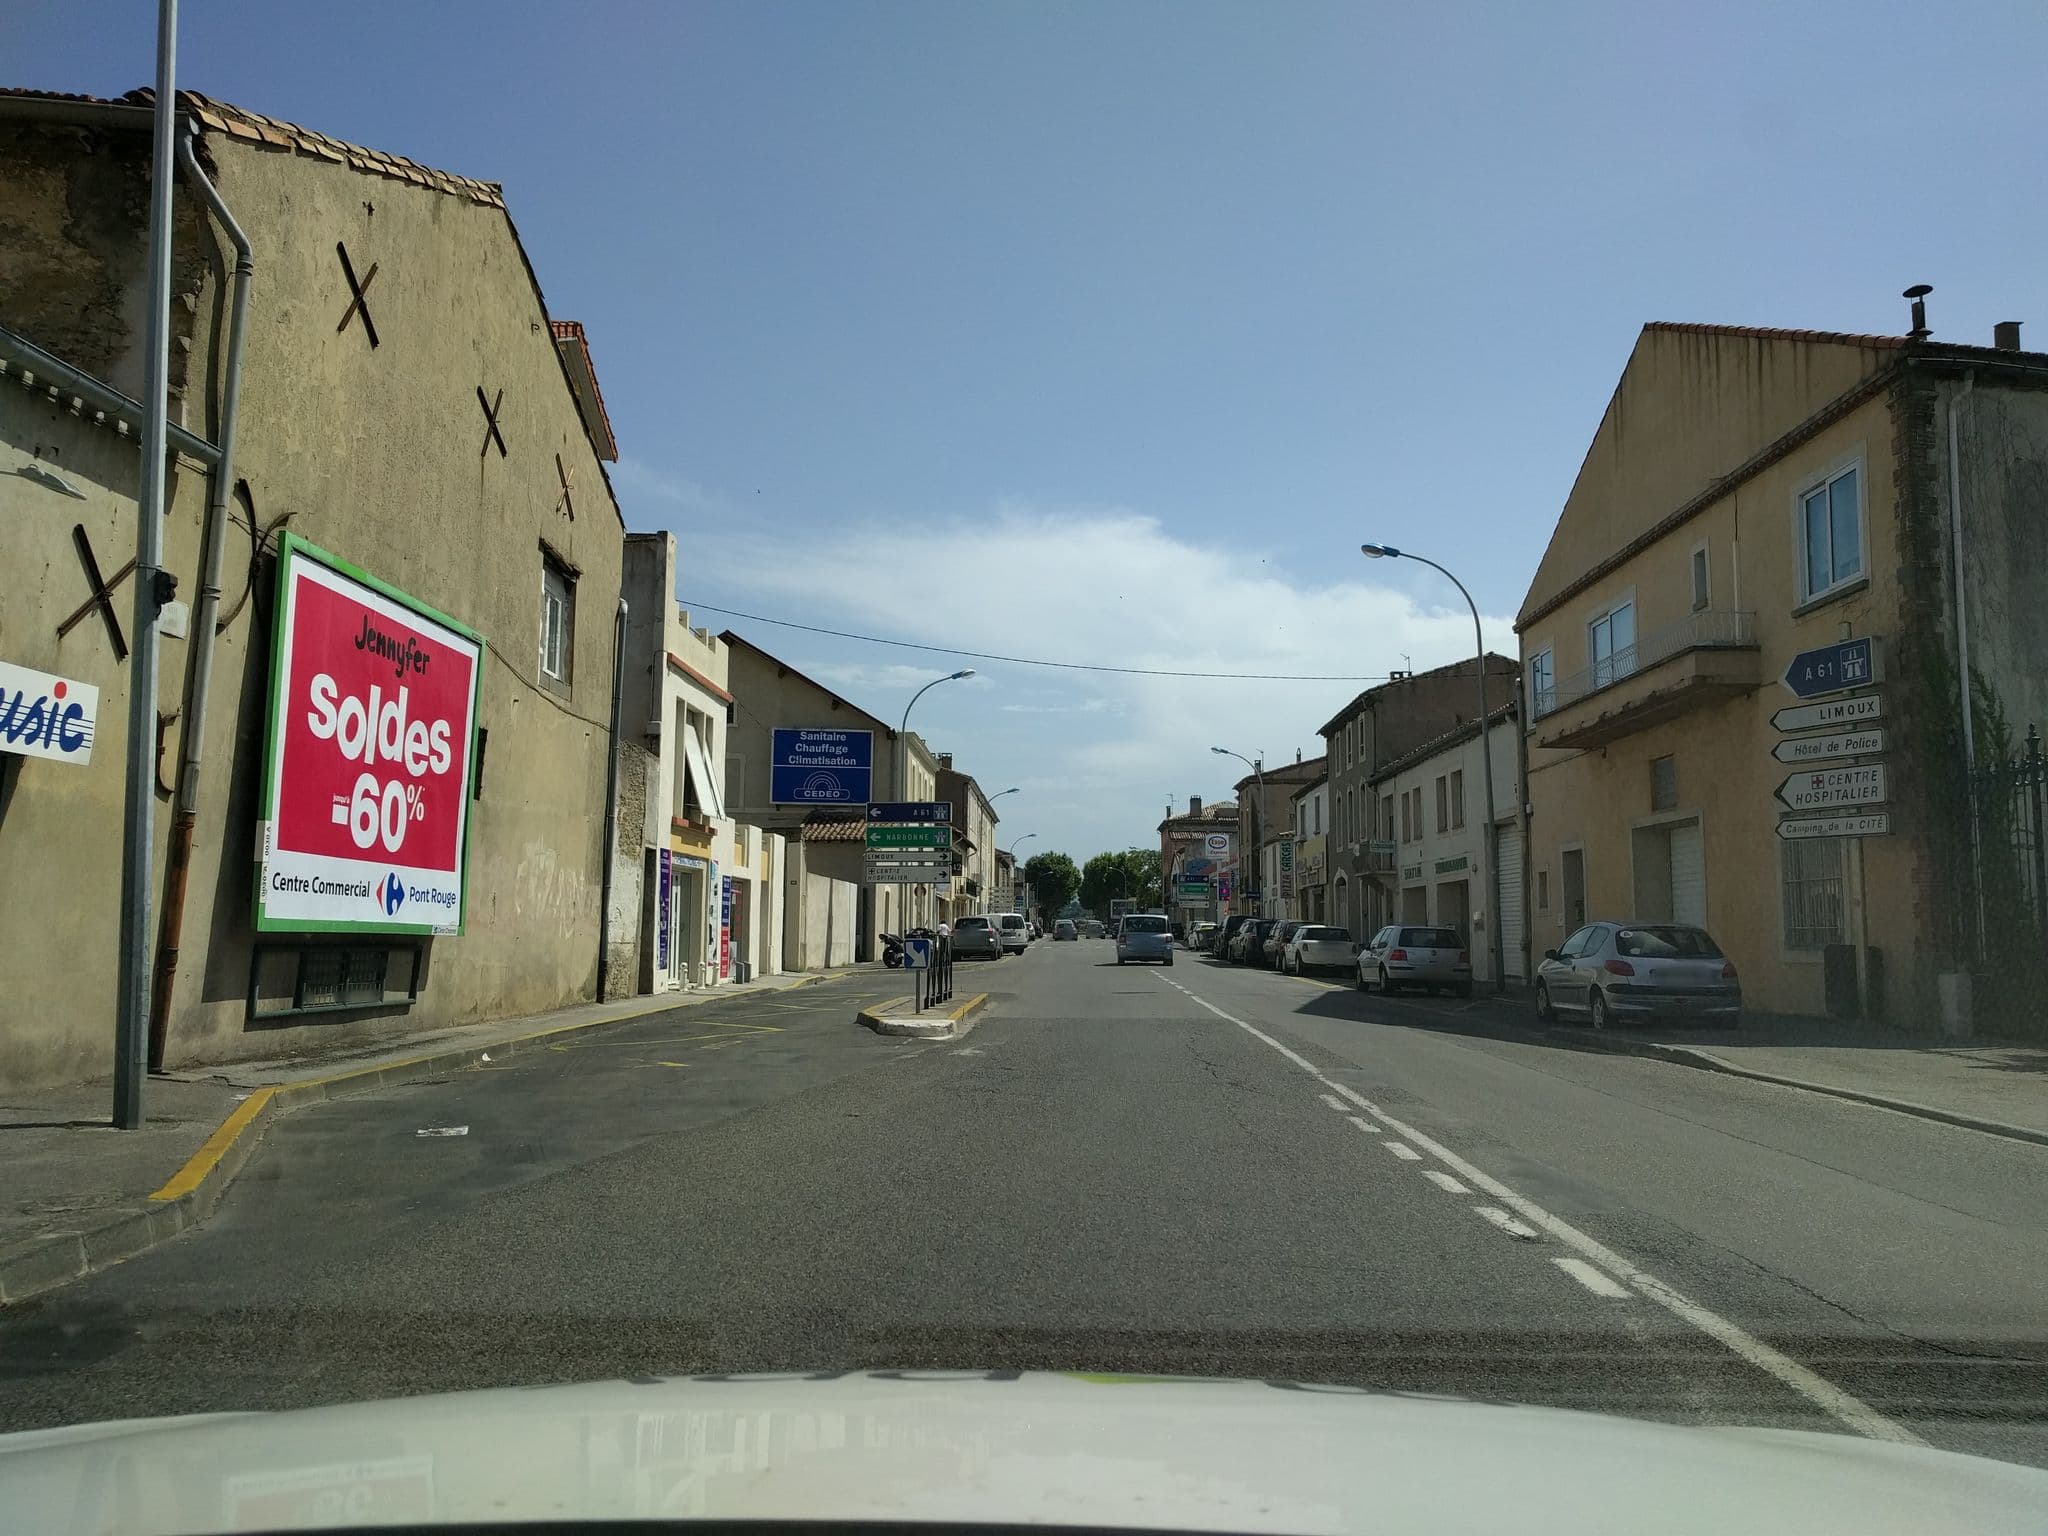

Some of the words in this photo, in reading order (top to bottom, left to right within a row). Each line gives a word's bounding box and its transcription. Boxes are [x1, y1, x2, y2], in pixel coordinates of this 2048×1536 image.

[355, 615, 430, 678] Jennyfer
[1805, 667, 1812, 681] A
[1817, 662, 1833, 678] 61
[1819, 701, 1875, 720] LIMOUX
[307, 673, 451, 777] Soldes
[799, 731, 847, 742] Sanitaire
[795, 743, 848, 755] Chauffage
[1794, 742, 1822, 756] Hôtel
[1827, 741, 1839, 752] de
[1845, 737, 1878, 750] Police
[788, 755, 857, 766] Climatisation
[1828, 770, 1878, 786] CENTRE
[803, 790, 840, 798] CEDEO
[1795, 786, 1878, 805] HOSPITALIER
[920, 808, 930, 816] 61
[1786, 824, 1823, 834] Camping
[1828, 822, 1839, 831] de
[1845, 822, 1854, 830] la
[1859, 816, 1883, 830] CITÉ
[886, 833, 929, 841] NARBONNE
[272, 872, 309, 893] Centre
[311, 876, 370, 898] Commercial
[1282, 874, 1293, 897] PIZZA
[409, 886, 430, 903] Pont
[431, 888, 456, 908] Rouge
